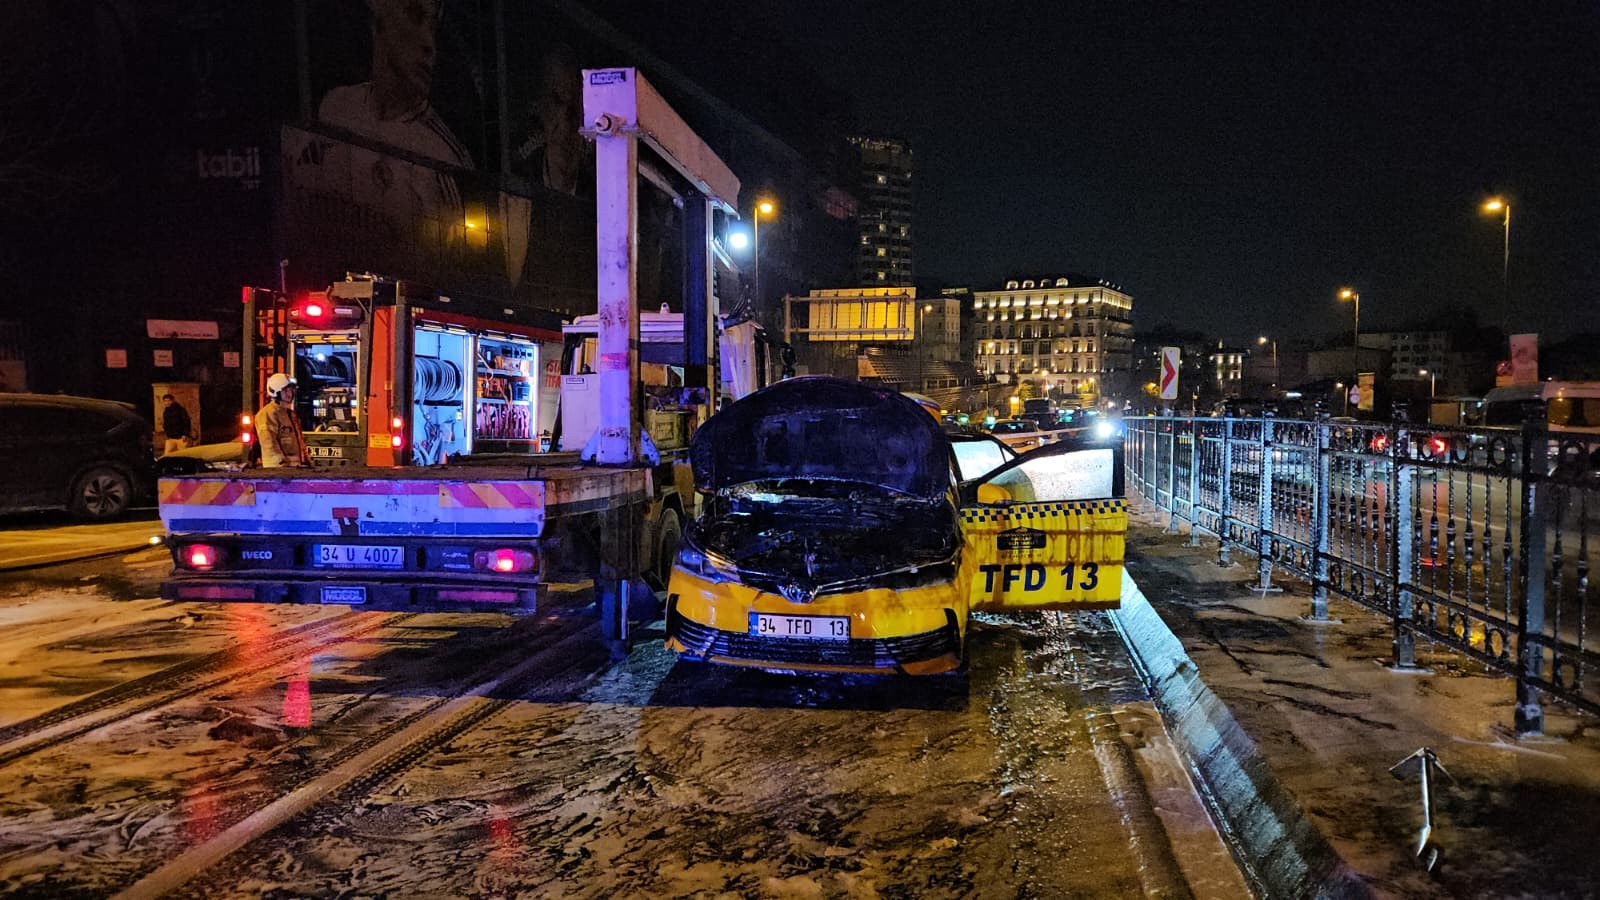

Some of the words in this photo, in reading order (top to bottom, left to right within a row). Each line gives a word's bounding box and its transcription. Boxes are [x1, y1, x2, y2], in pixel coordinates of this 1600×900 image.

[242, 551, 273, 559] IVECO
[322, 547, 338, 561] 34
[347, 547, 355, 561] U
[364, 548, 399, 563] 4007
[979, 563, 1047, 593] TFD
[1060, 561, 1099, 591] 13
[760, 617, 776, 633] 34
[786, 618, 812, 635] TFD
[829, 620, 844, 636] 13
